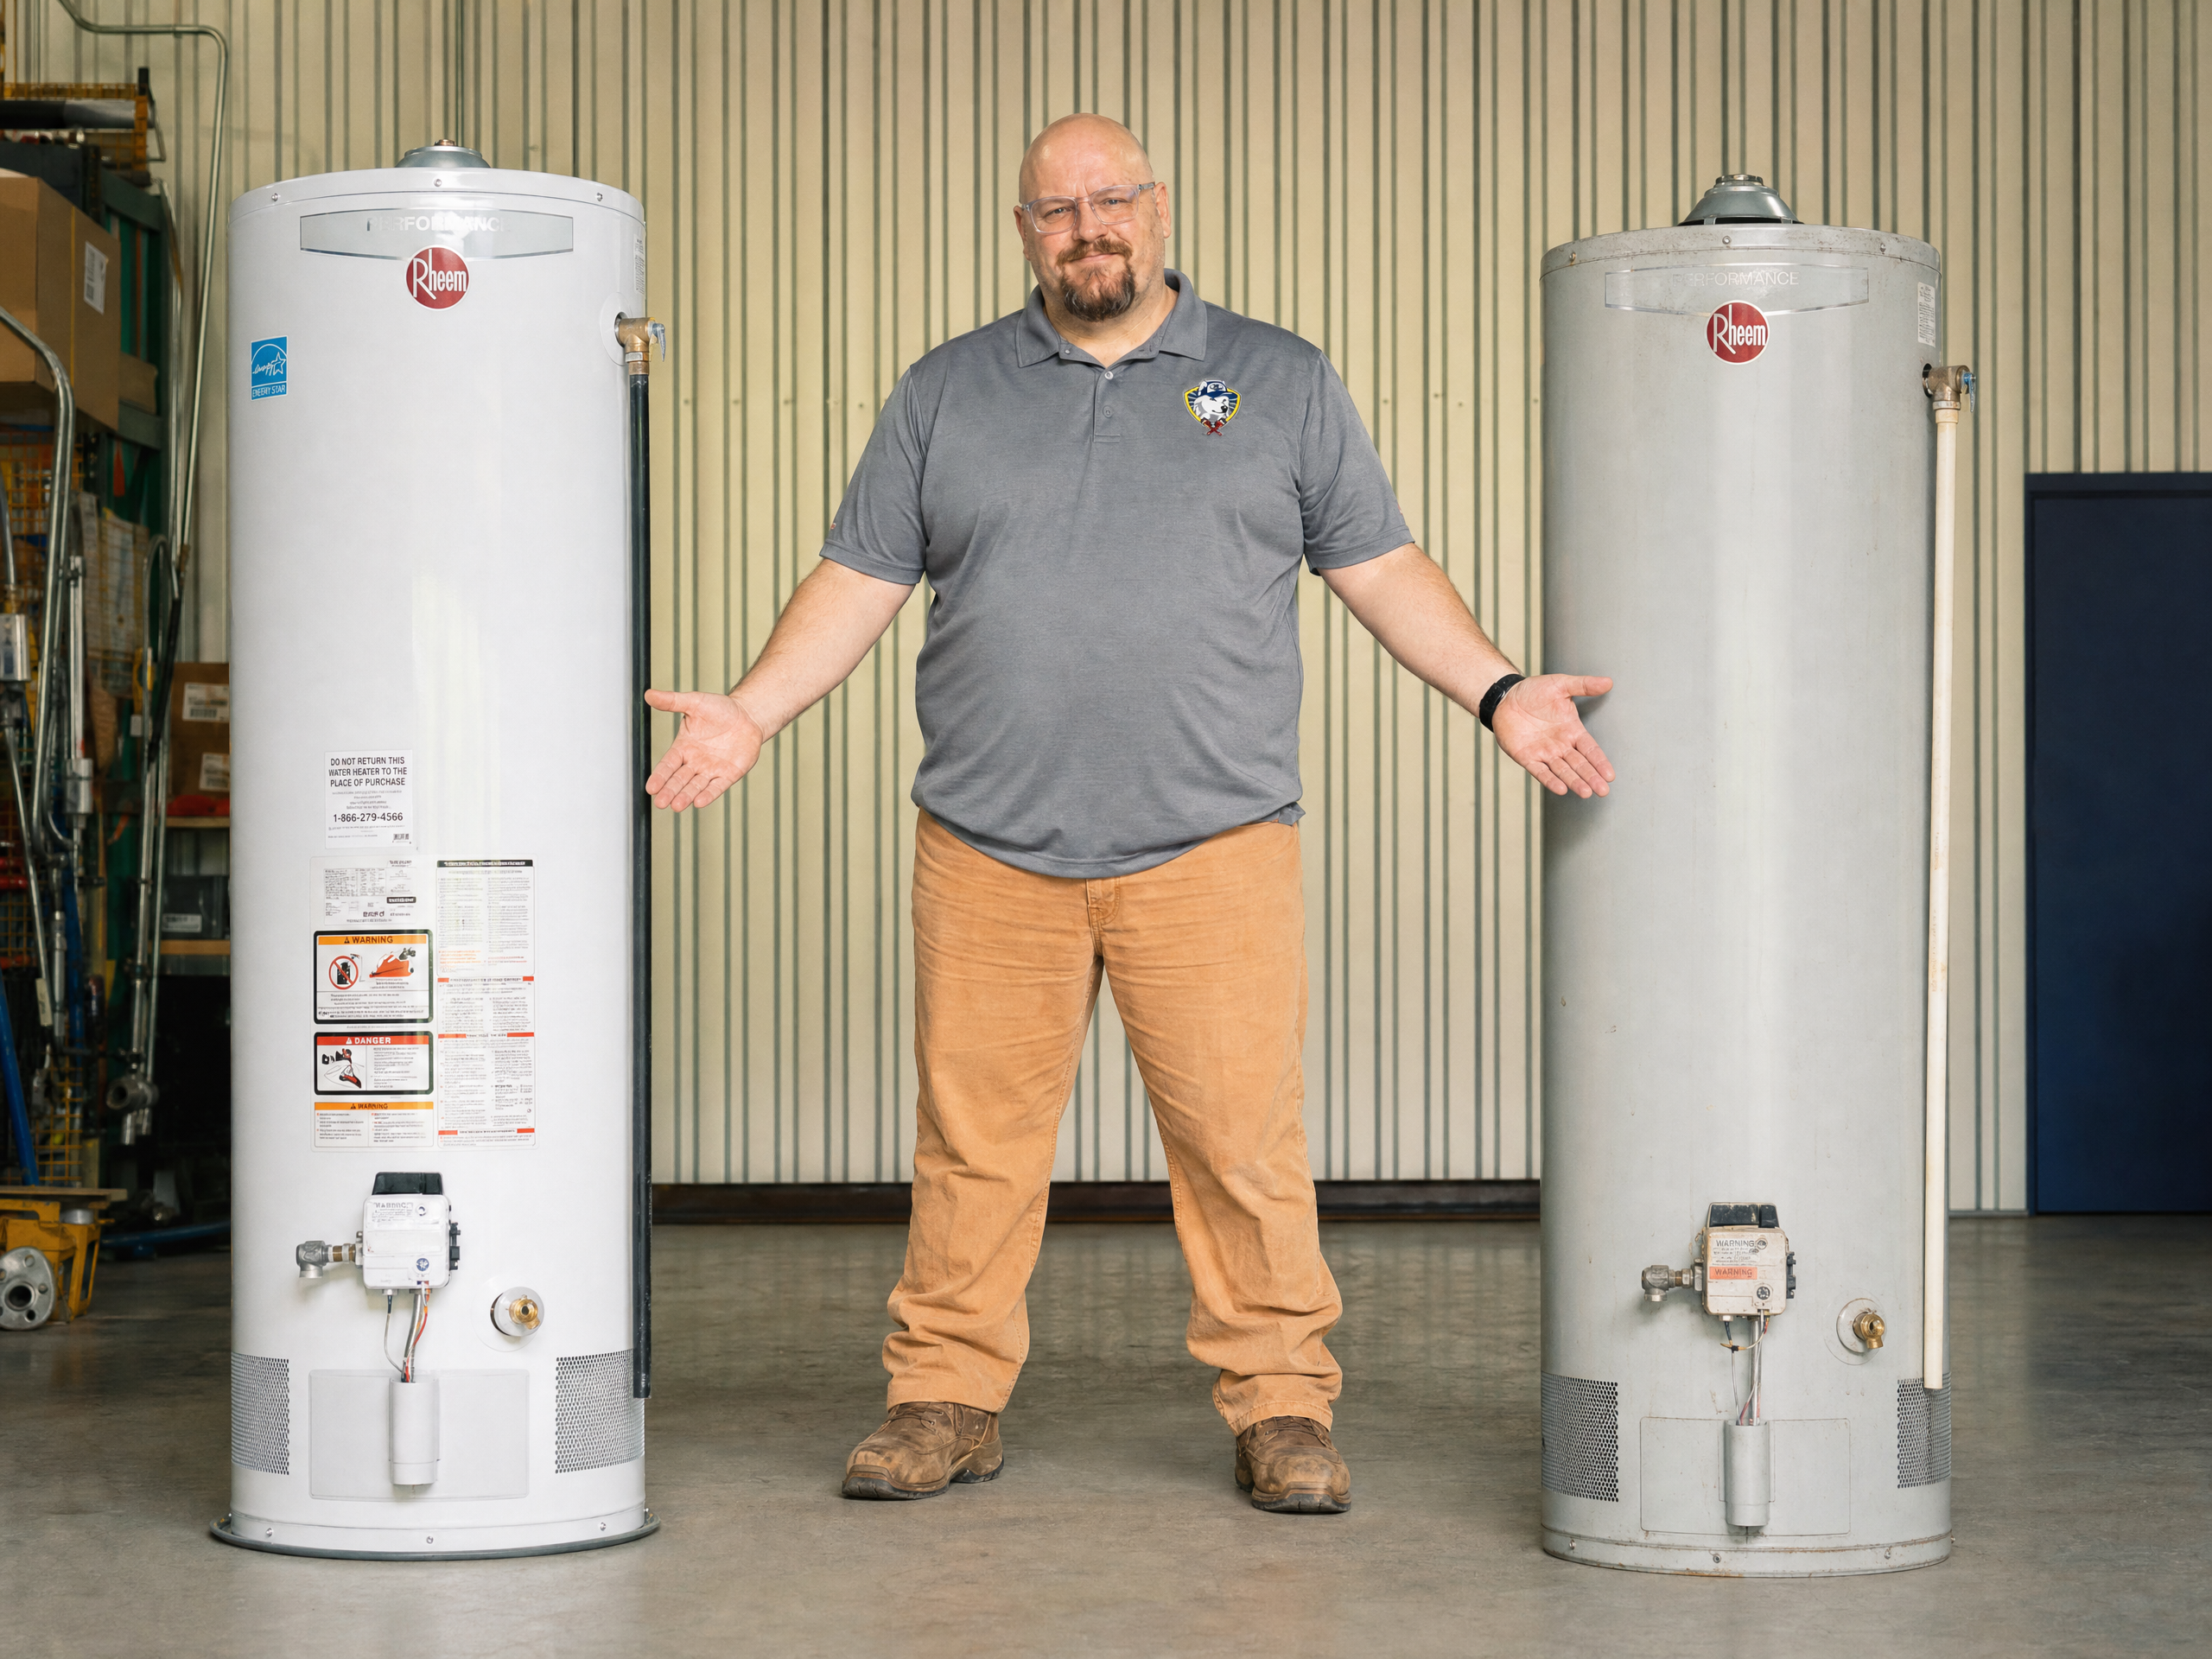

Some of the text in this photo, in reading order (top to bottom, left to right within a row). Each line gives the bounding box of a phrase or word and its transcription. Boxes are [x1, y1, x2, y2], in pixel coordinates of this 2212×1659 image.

[413, 248, 467, 300] Rheem
[1672, 271, 1800, 287] PERFORMANCE
[1713, 303, 1766, 355] Rheem
[271, 385, 286, 394] STAR
[330, 756, 405, 766] DO NOT RETURN THIS
[353, 767, 380, 776] HEATER
[330, 779, 352, 787] PLACE
[365, 778, 405, 786] PURCHASE
[333, 812, 404, 823] 1-866-279-4566
[1714, 1268, 1752, 1277] WARNING
